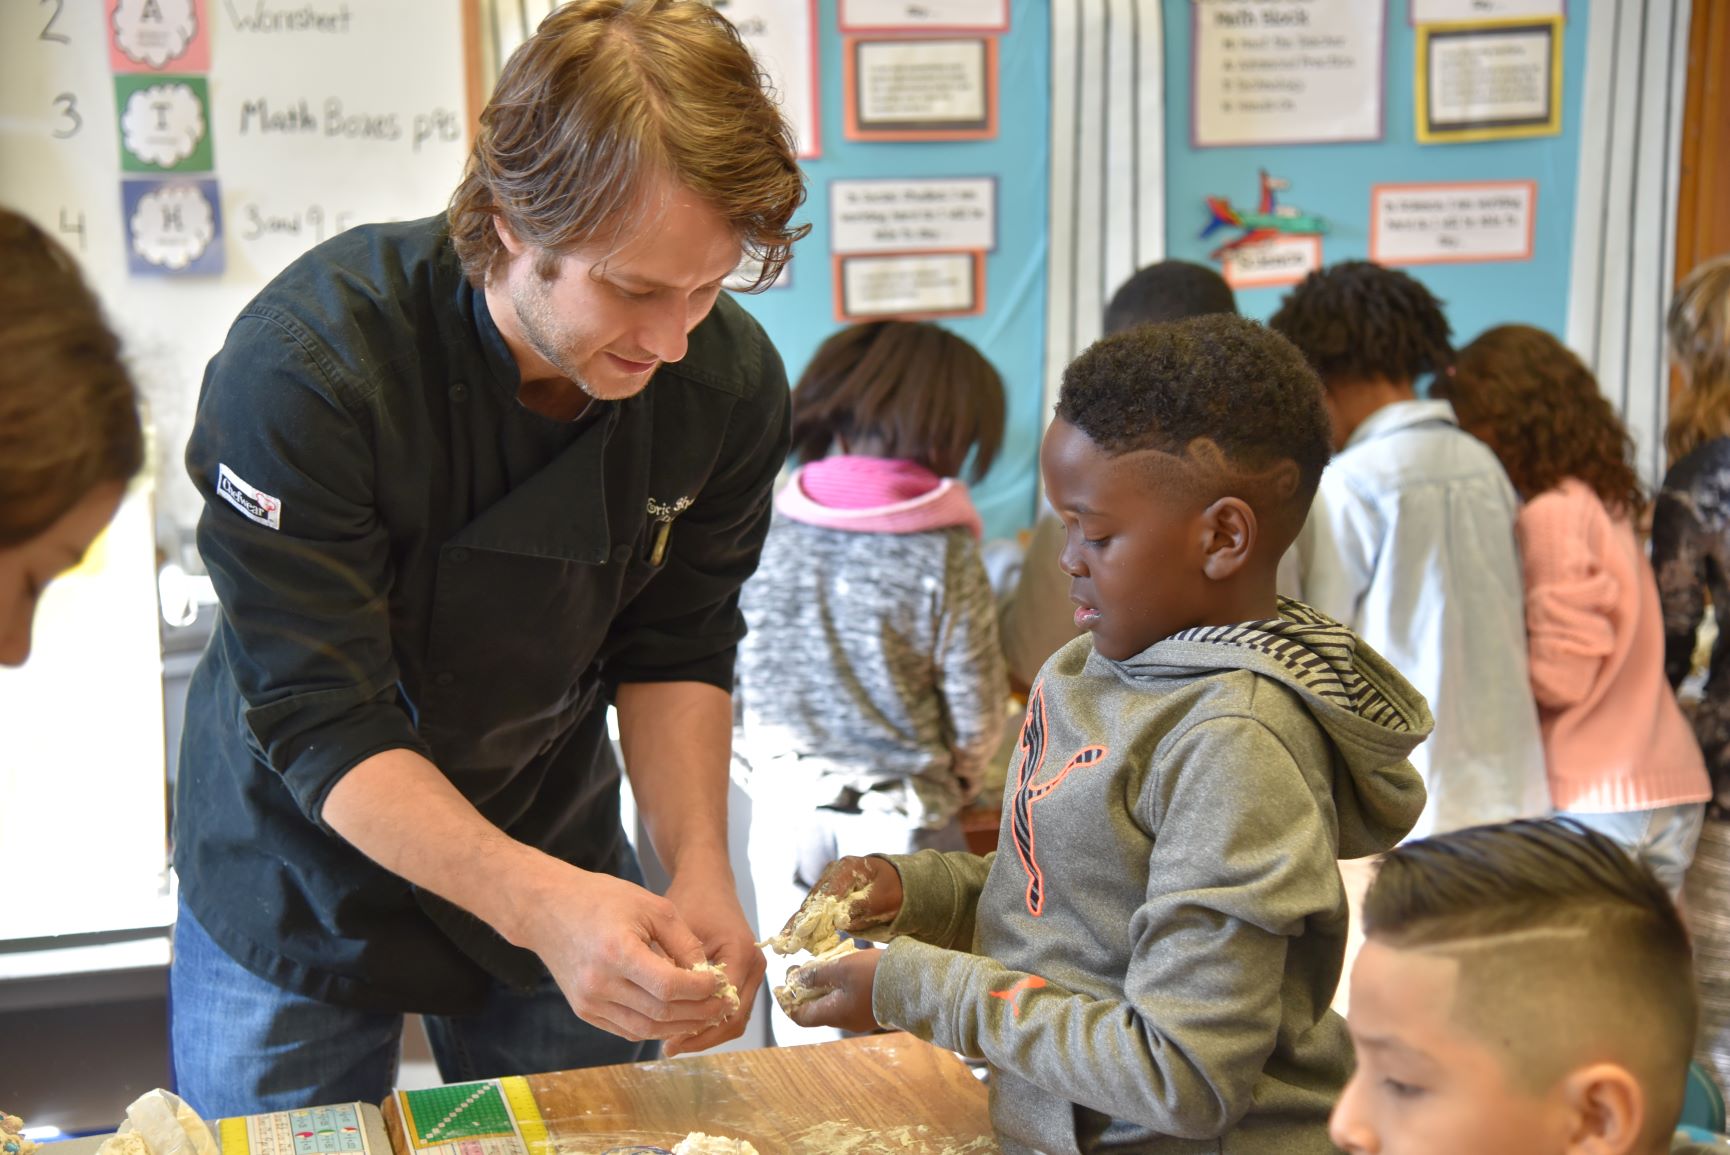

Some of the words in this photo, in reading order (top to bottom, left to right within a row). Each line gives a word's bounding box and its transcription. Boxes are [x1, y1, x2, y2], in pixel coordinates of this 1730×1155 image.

[37, 0, 71, 44] 2
[141, 0, 163, 23] A
[52, 91, 83, 139] 3
[151, 102, 173, 130] T
[240, 97, 318, 136] Math
[323, 96, 403, 141] Boxes
[59, 208, 86, 249] 4
[163, 204, 183, 232] H
[222, 478, 265, 517] Chefwear
[647, 497, 672, 516] Eric
